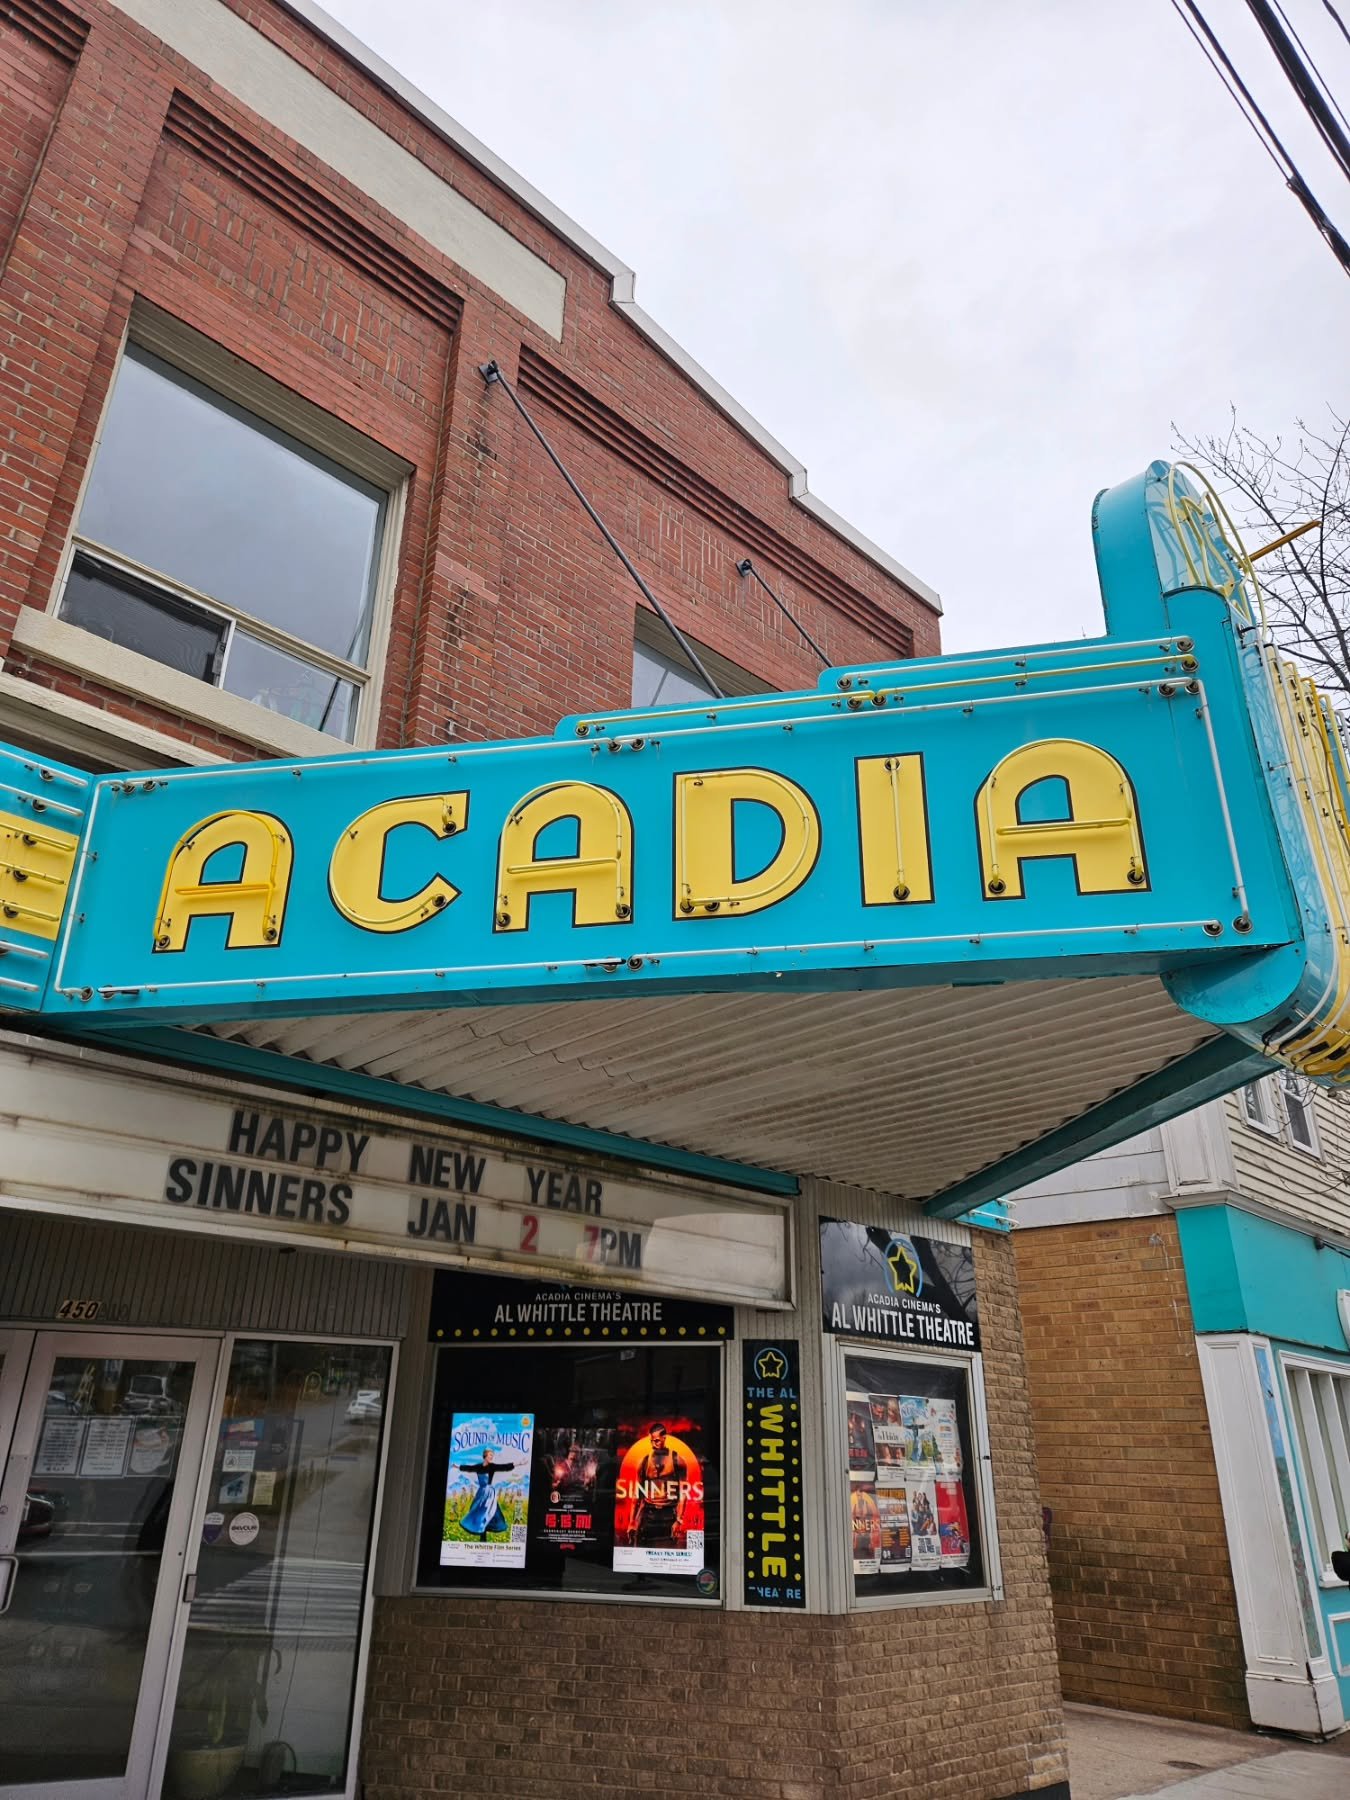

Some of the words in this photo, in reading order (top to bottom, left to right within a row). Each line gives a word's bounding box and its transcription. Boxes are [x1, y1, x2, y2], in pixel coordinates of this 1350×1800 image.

[152, 737, 1152, 953] ACADIA
[227, 1110, 370, 1173] HAPPY
[408, 1144, 486, 1194] NEW
[526, 1166, 603, 1217] YEAR
[166, 1158, 353, 1226] SINNERS
[407, 1198, 477, 1243] JAN
[520, 1215, 539, 1252] 2
[535, 1292, 571, 1301] ACADIA
[574, 1291, 622, 1300] CINEMA'S
[868, 1293, 899, 1308] ACADIA
[902, 1299, 941, 1314] CINEMA'S
[59, 1300, 99, 1319] 450
[494, 1303, 513, 1323] AL
[517, 1303, 586, 1322] WHITTLE
[590, 1302, 662, 1322] THEATRE
[832, 1302, 851, 1329] AL
[852, 1304, 915, 1338] WHITTLE
[916, 1314, 975, 1346] THEATRE
[746, 1387, 775, 1398] THE
[779, 1387, 797, 1399] AL
[453, 1431, 488, 1453] SOUND
[496, 1432, 530, 1453] MUSIC
[616, 1479, 704, 1500] SINNERS
[760, 1403, 787, 1578] WHITTLE
